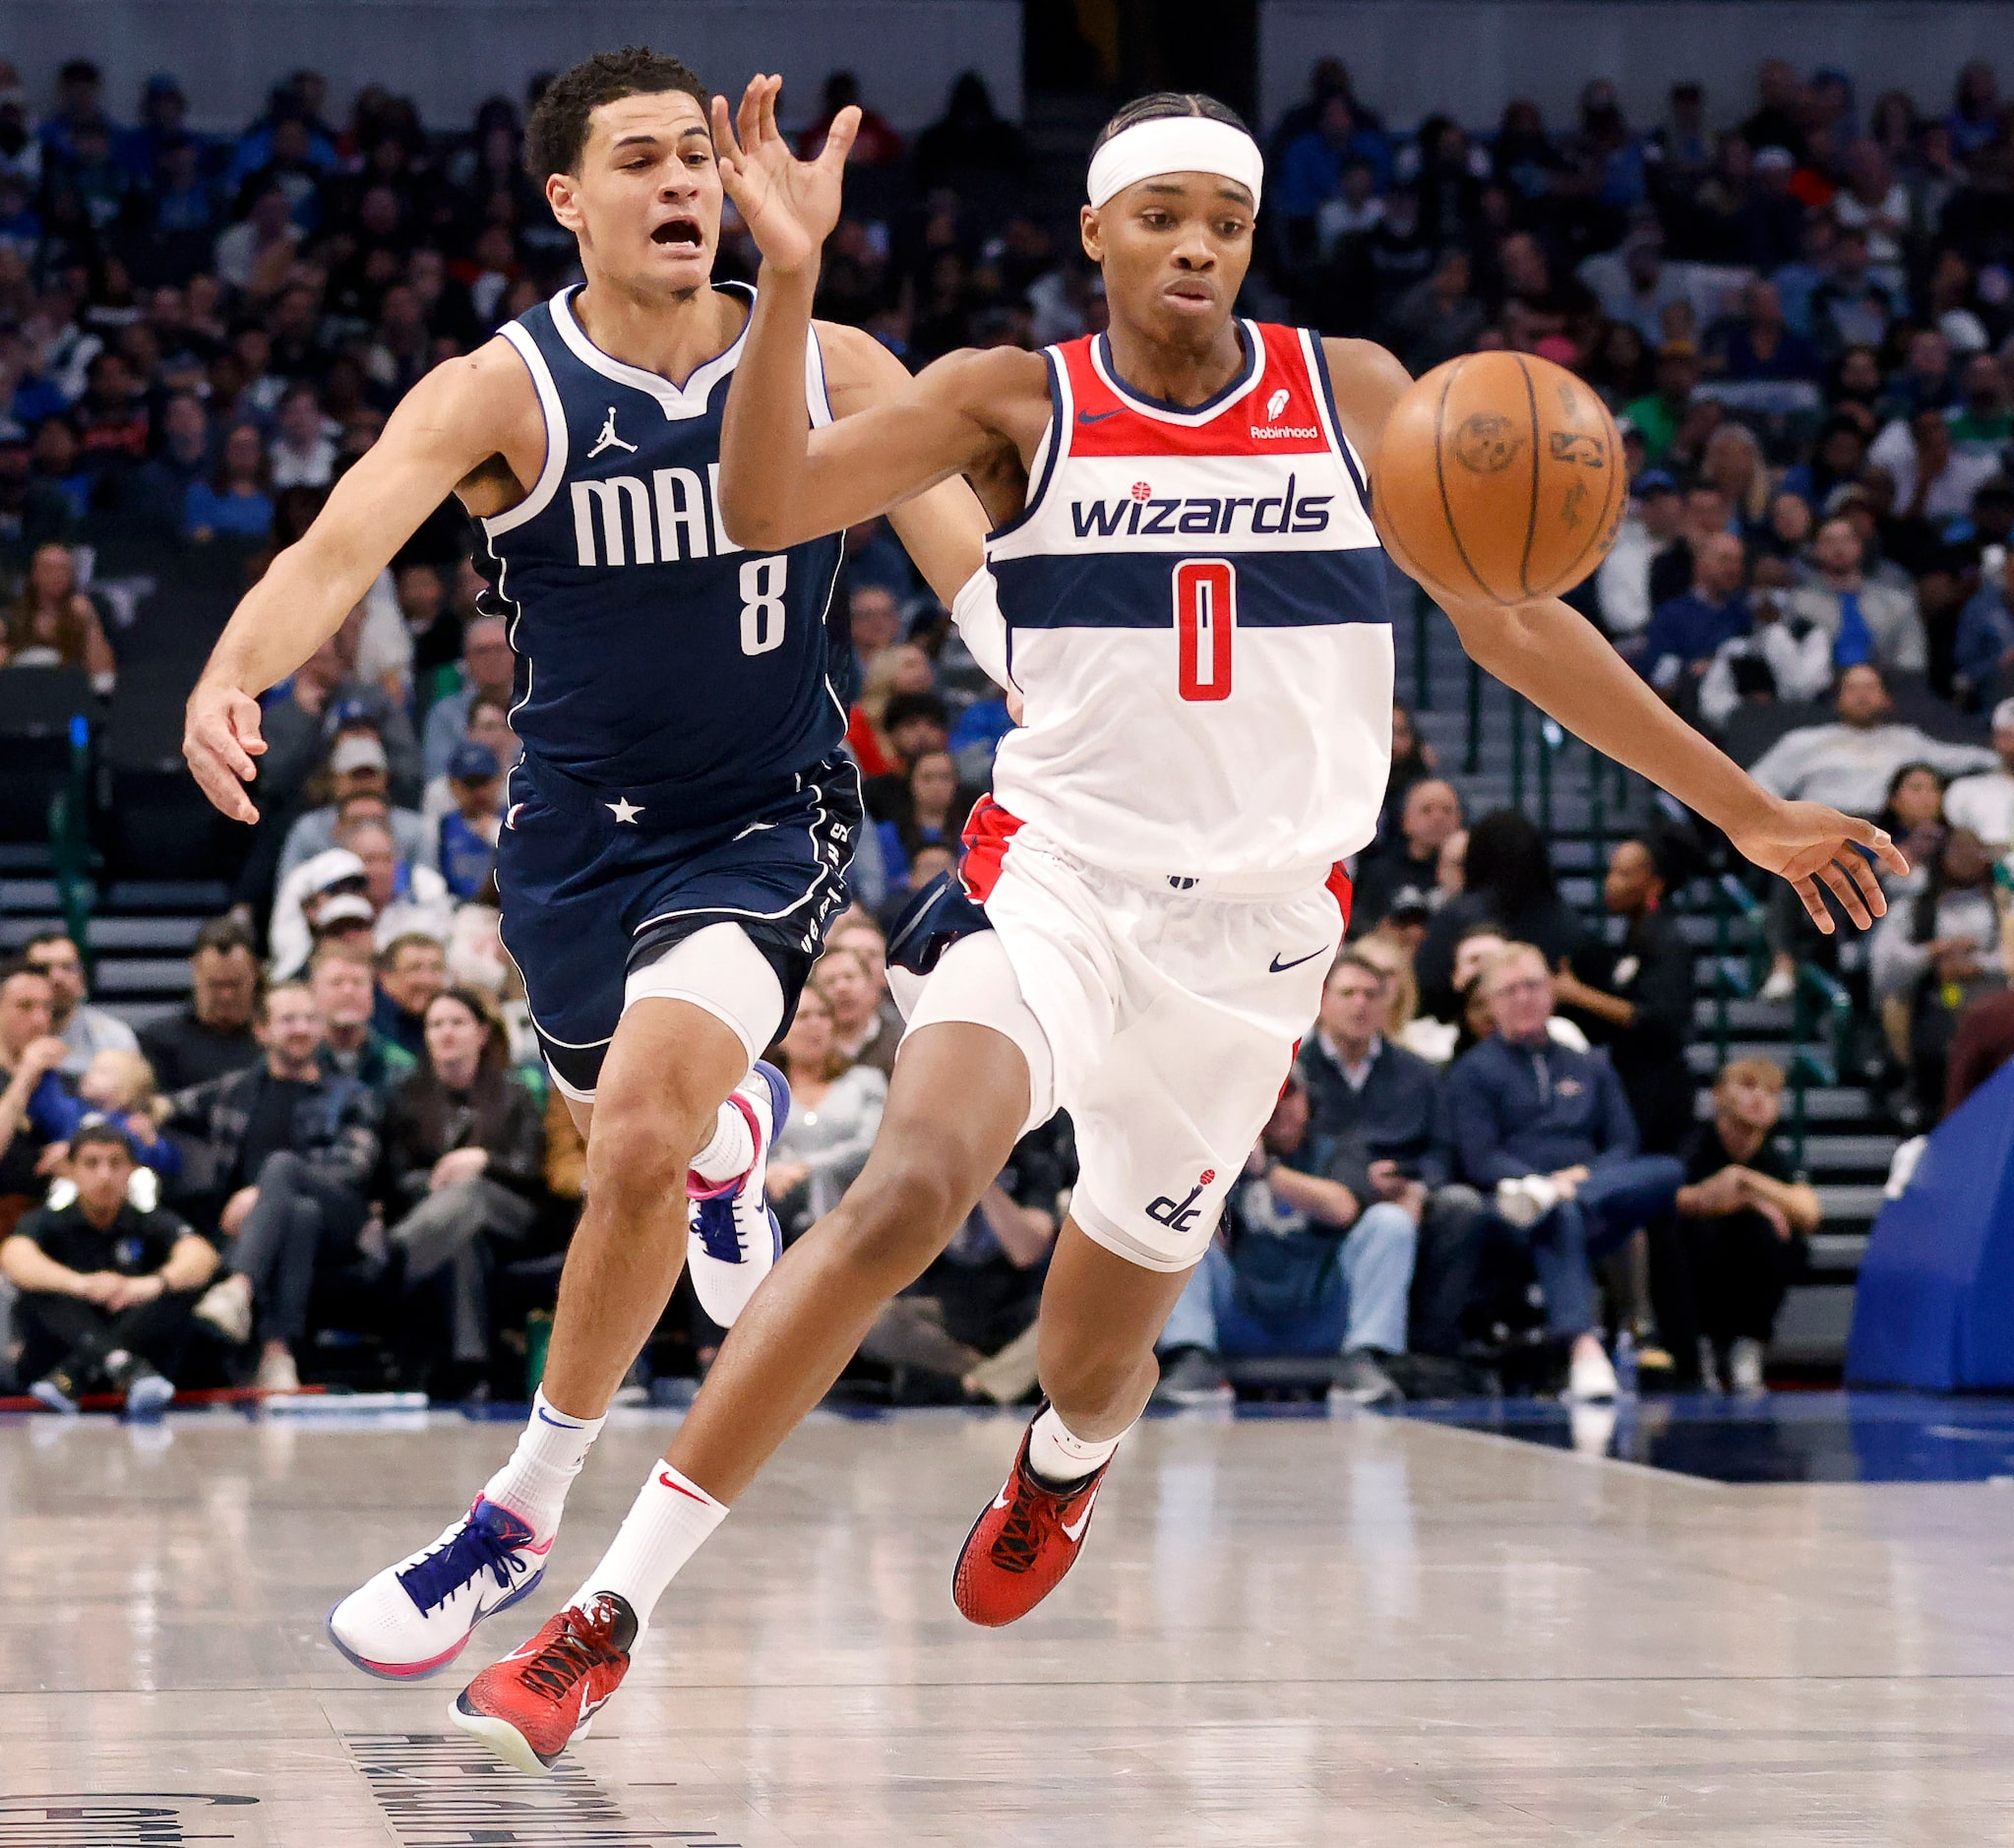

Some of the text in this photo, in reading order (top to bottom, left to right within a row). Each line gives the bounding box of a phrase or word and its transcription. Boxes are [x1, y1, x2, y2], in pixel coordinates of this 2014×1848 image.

[1251, 425, 1318, 440] Robinhood
[1071, 472, 1335, 537] wizards
[739, 554, 788, 656] 8
[1174, 560, 1235, 704] 0
[1145, 1182, 1204, 1232] dc
